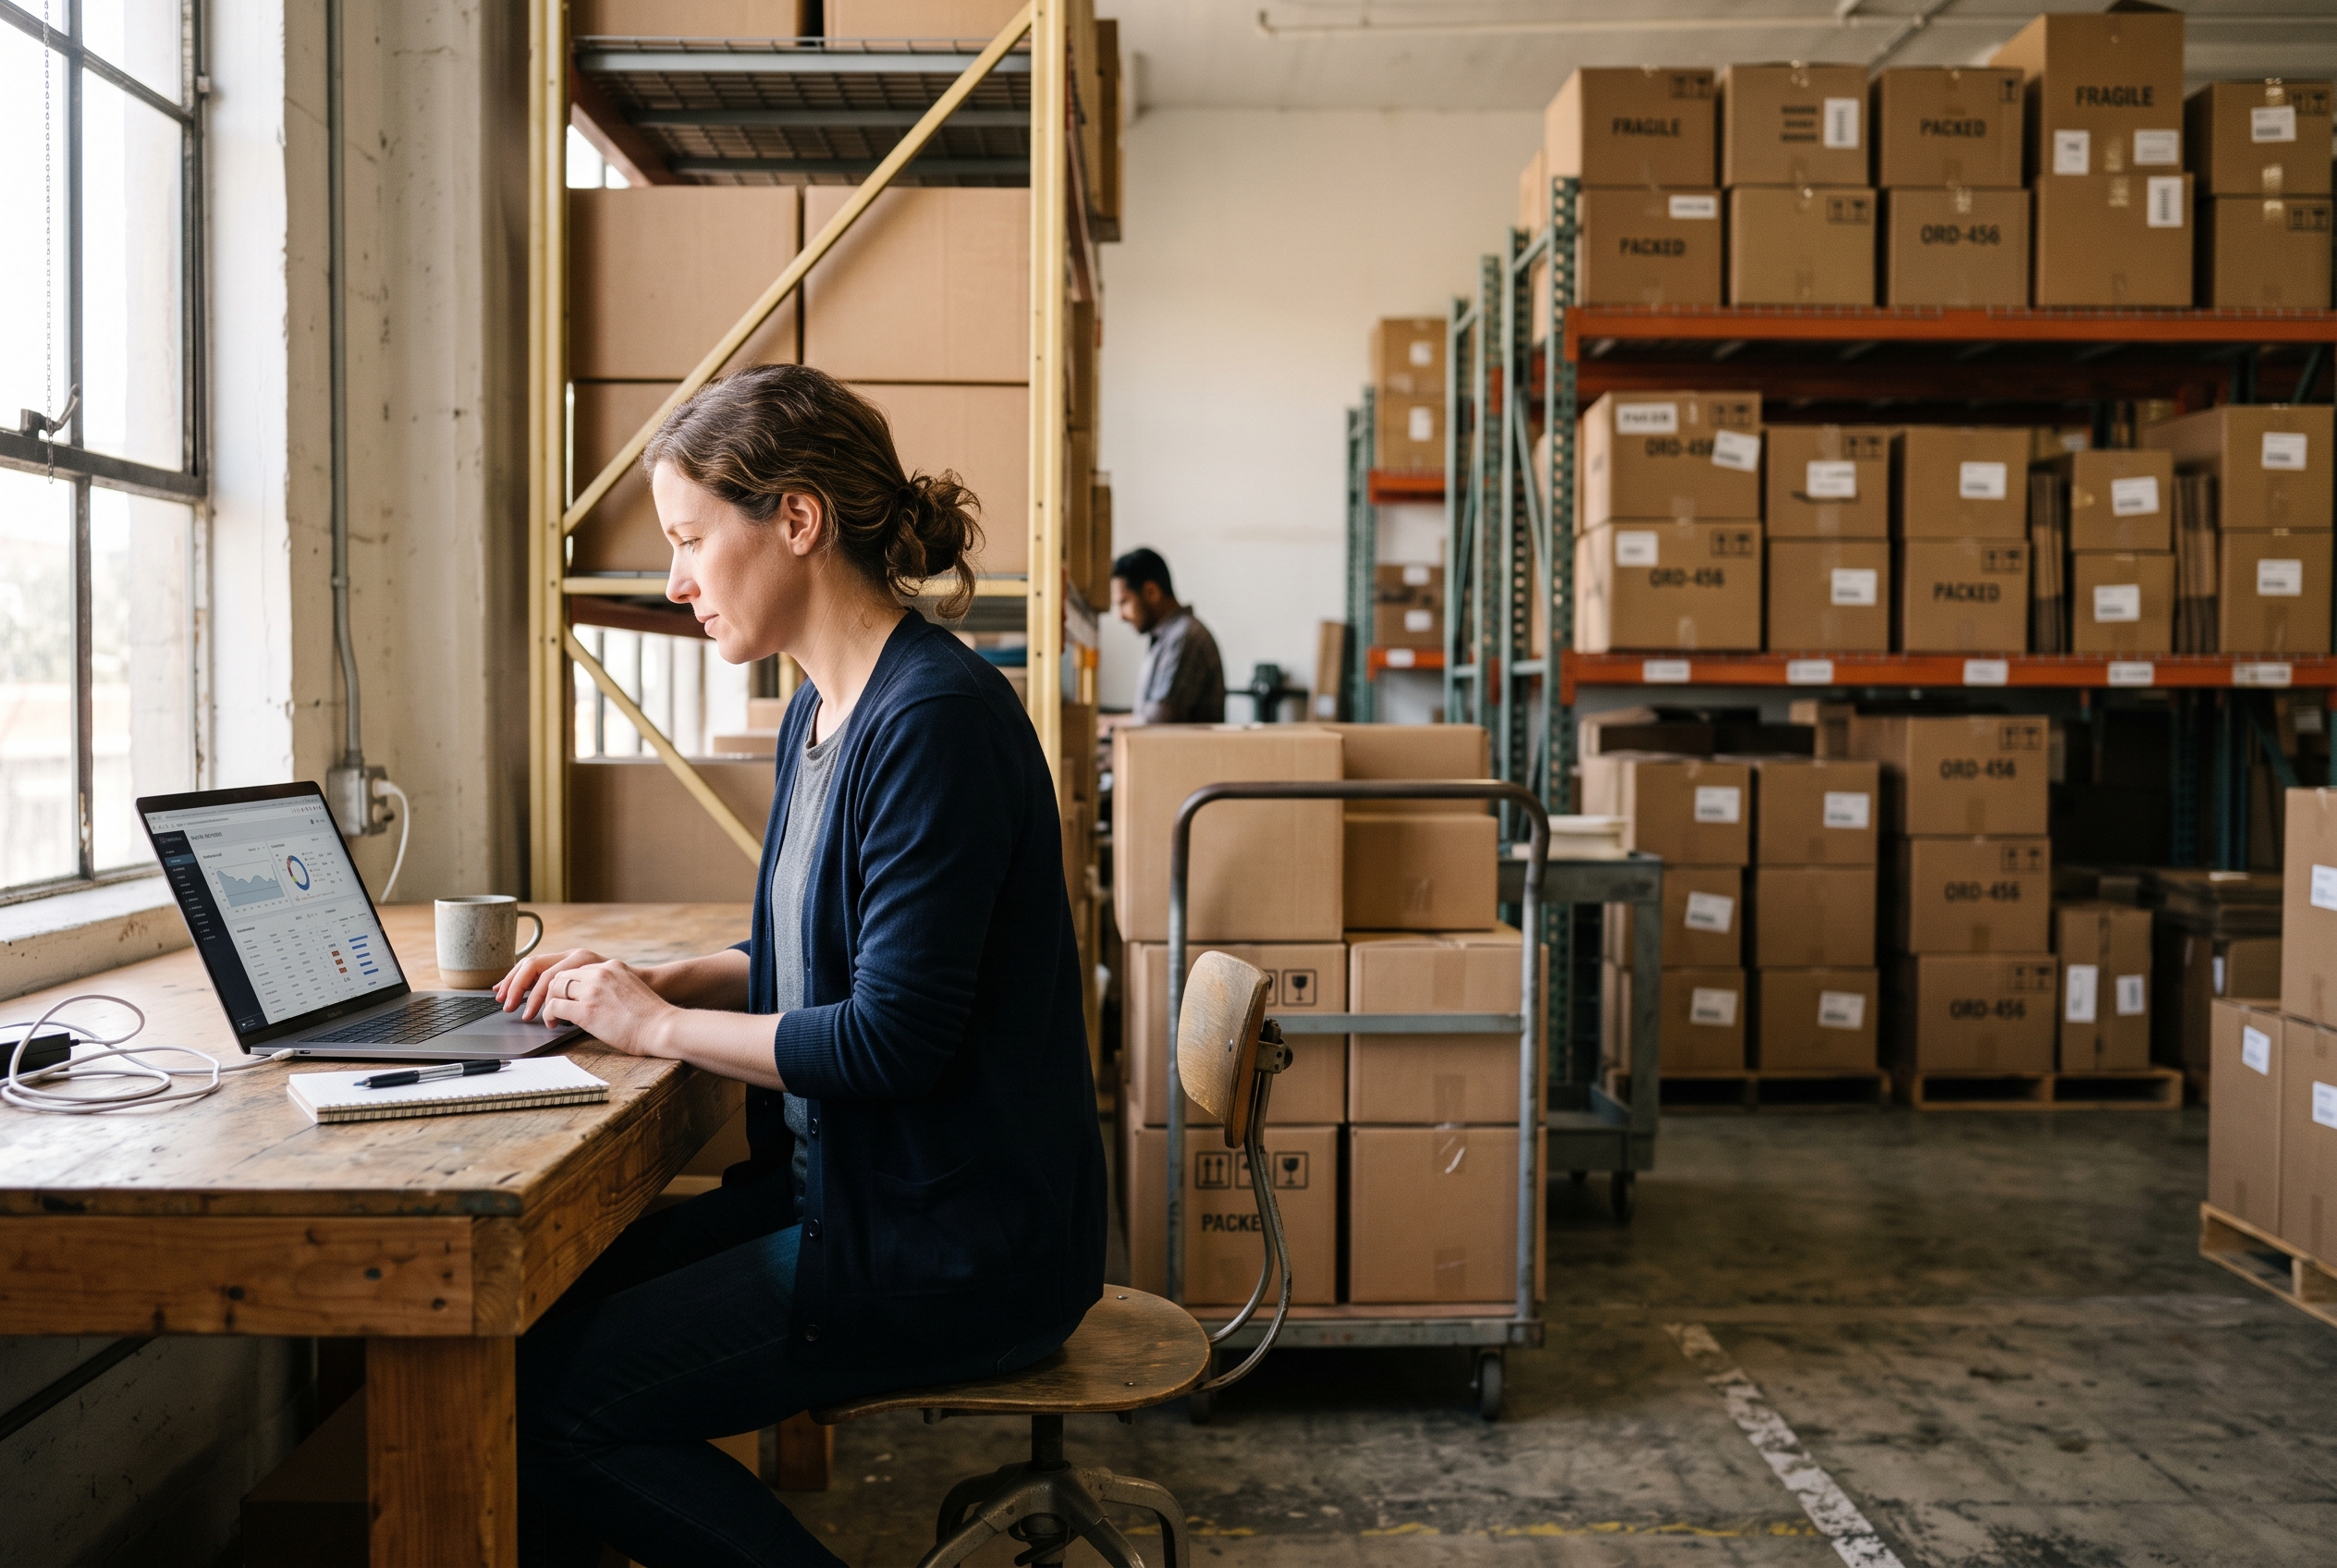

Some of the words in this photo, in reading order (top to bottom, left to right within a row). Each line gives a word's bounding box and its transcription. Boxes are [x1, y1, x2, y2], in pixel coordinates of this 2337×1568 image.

[2075, 85, 2155, 108] FRAGILE
[1611, 117, 1682, 138] FRAGILE
[1920, 118, 1988, 139] PACKED
[1920, 225, 2001, 246] ORD-456
[1619, 238, 1687, 258] PACKED
[1648, 567, 1726, 589] ORD-456
[1933, 582, 2001, 604] PACKED
[1939, 758, 2017, 780] ORD-456
[1943, 881, 2022, 903] ORD-456
[1949, 998, 2026, 1021] ORD-456
[1201, 1212, 1263, 1232] PACKE
